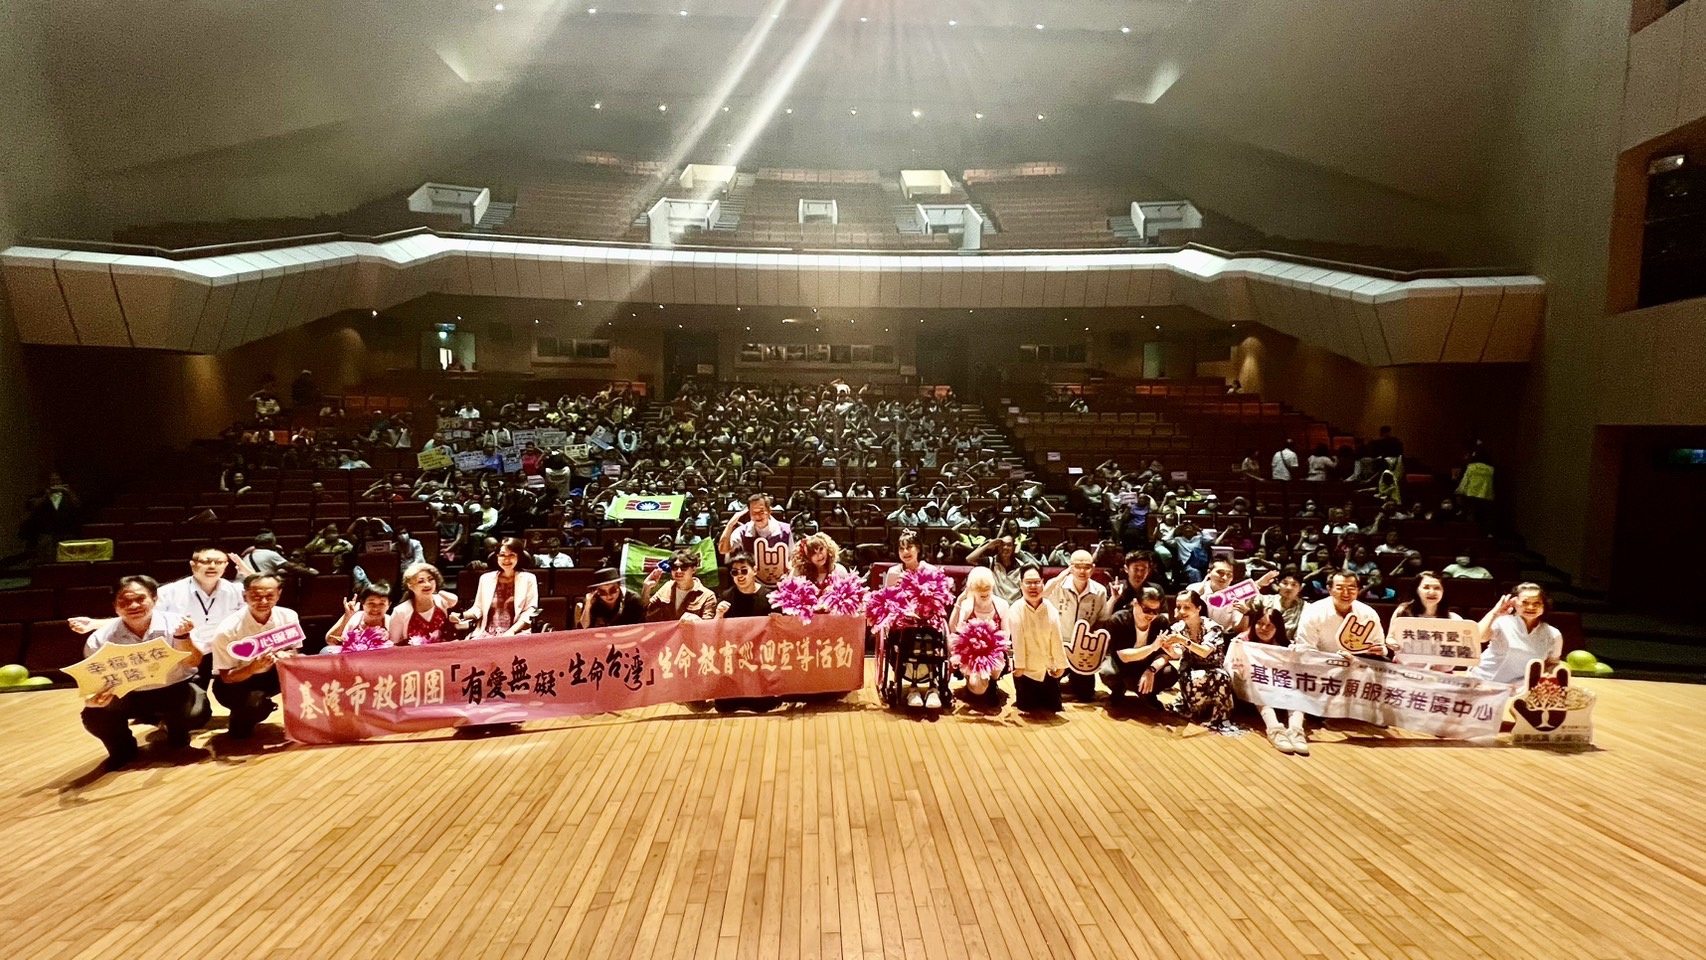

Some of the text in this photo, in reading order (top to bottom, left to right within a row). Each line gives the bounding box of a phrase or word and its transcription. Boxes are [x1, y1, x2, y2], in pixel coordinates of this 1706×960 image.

[1440, 645, 1475, 658] 基隆
[1250, 663, 1493, 721] 基隆市志願服務推廣中心
